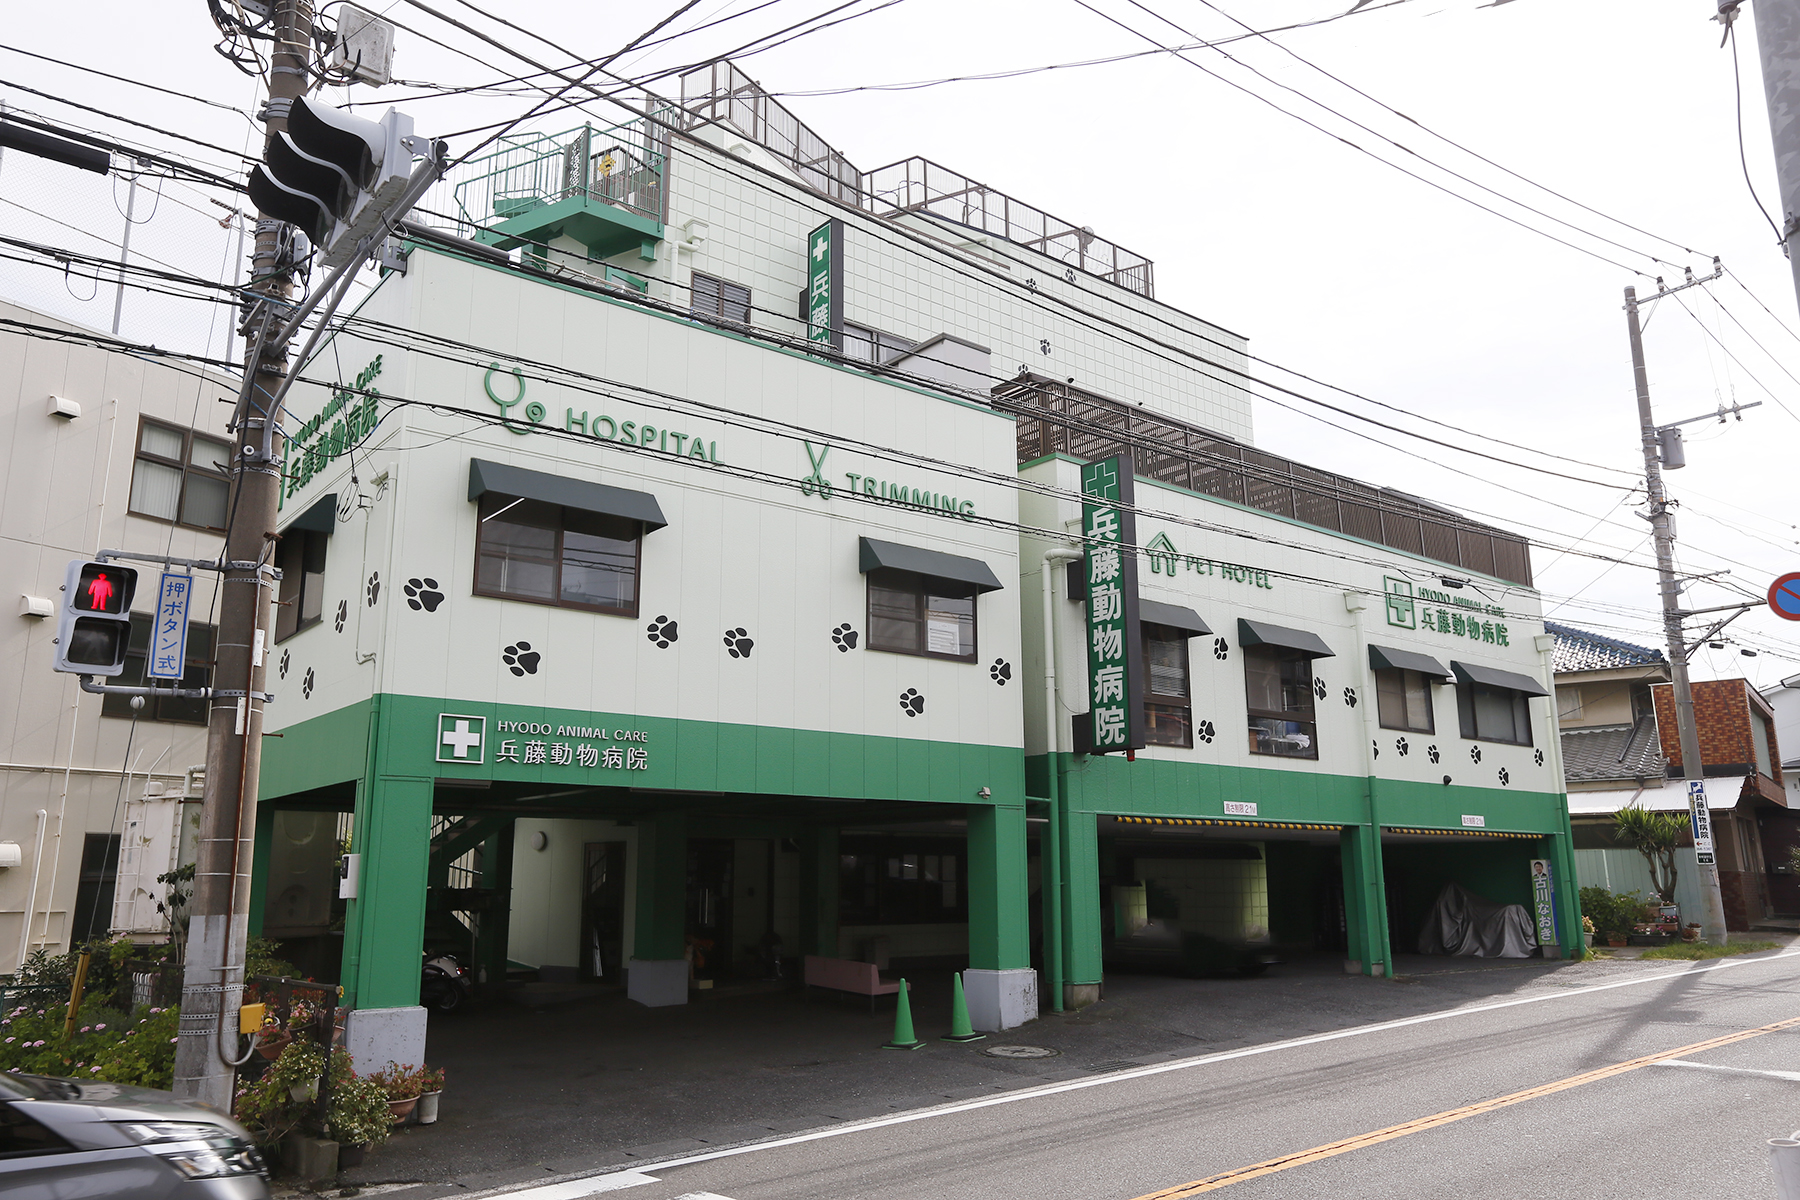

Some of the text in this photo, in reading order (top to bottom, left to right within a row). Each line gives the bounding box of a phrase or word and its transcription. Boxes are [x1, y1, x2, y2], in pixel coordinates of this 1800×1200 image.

[356, 354, 383, 390] CARE
[286, 387, 379, 499] 兵藤動物病院
[566, 407, 725, 465] HOSPITAL
[845, 472, 976, 521] TRIMMING
[1221, 562, 1274, 590] HOTEL
[1418, 586, 1451, 604] HYODO
[158, 581, 186, 671] 押ボタン式
[1087, 505, 1126, 746] 兵藤動物病院
[1421, 606, 1510, 647] 兵藤動物病院
[497, 720, 649, 743] HYODO ANIMAL CARE
[496, 739, 648, 771] 兵藤動物病院
[1695, 793, 1709, 839] 兵藤動物病院
[1533, 874, 1552, 941] 古川なおき
